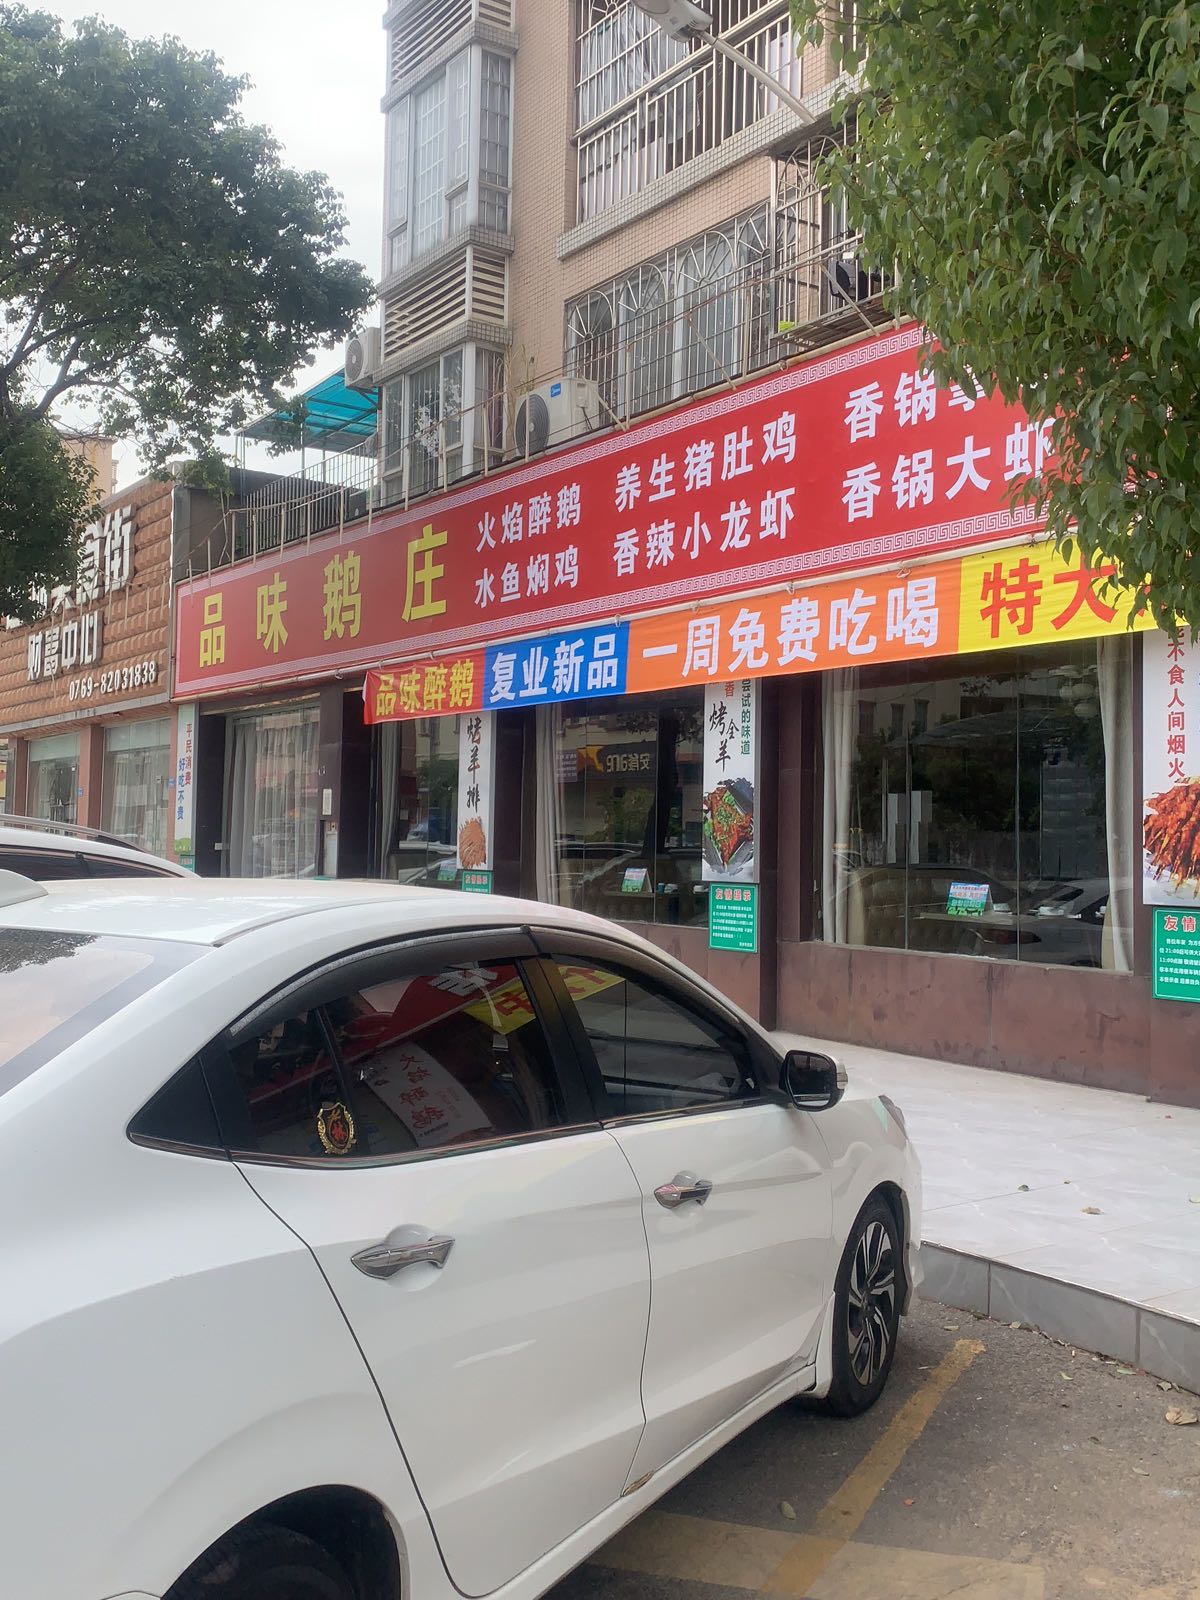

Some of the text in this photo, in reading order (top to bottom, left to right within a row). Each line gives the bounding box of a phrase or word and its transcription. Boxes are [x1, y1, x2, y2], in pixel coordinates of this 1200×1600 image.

[474, 417, 1056, 609] 水鱼焖鸡 香辣小龙虾 香锅大虾
[475, 482, 581, 552] 火焰醉鹅
[615, 410, 797, 512] 养生猪肚鸡
[199, 523, 448, 668] 品味鹅庄
[375, 552, 1153, 716] 品味醉鹅 复业新品 一周免费吃喝 特大
[69, 660, 157, 701] 0769-82031838
